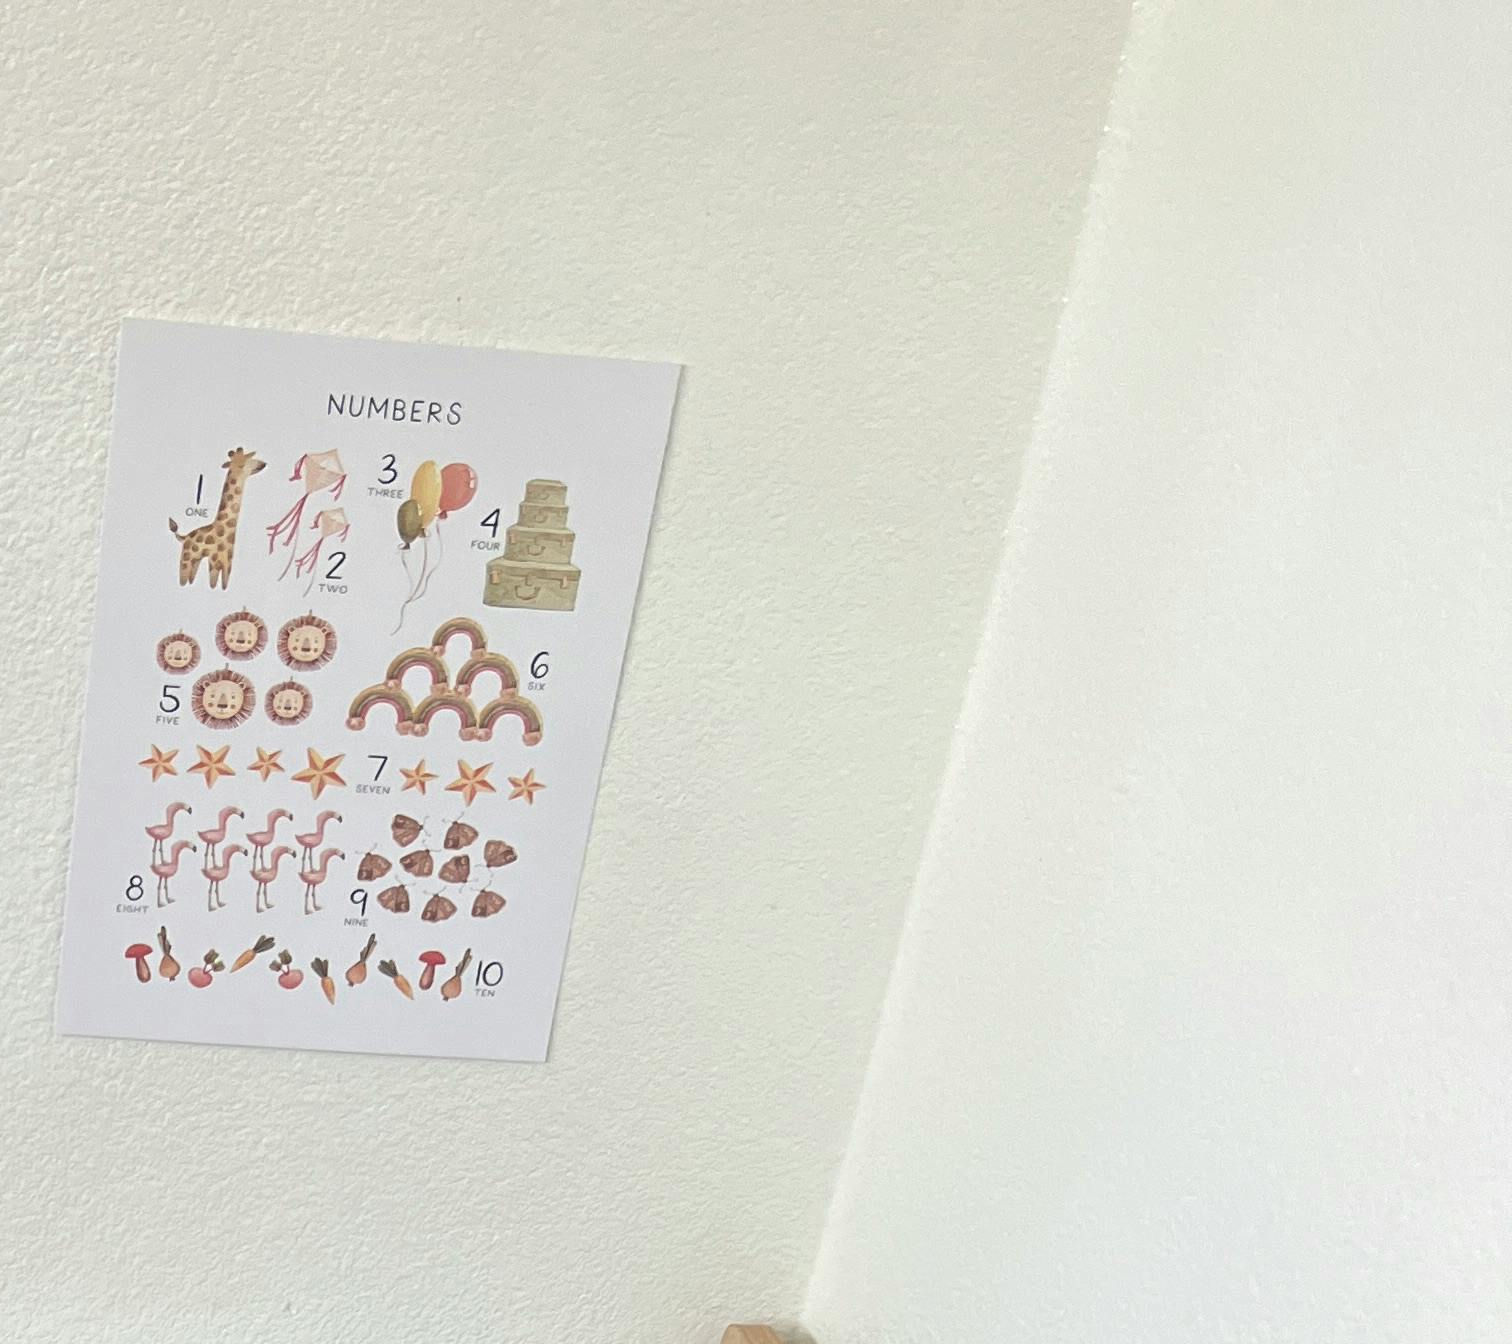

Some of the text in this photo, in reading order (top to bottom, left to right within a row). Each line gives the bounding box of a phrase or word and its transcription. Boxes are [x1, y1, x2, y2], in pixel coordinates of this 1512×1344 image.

[327, 393, 462, 425] NUMBERS
[377, 454, 398, 484] 3
[196, 473, 203, 505] 1
[367, 487, 405, 500] THREE
[185, 507, 209, 518] ONE
[480, 508, 501, 538] 4
[470, 540, 501, 552] FOUR
[325, 551, 347, 580] 2
[318, 583, 348, 595] TWO
[530, 651, 549, 679] 6
[159, 684, 181, 713] 5
[528, 681, 546, 691] SIX
[155, 715, 181, 726] FIVE
[367, 755, 388, 781] 7
[355, 783, 391, 795] SEVEN
[126, 875, 144, 901] 8
[115, 904, 149, 914] EIGHT
[350, 889, 368, 917] 9
[344, 918, 368, 927] NINE
[475, 960, 504, 987] 10
[475, 989, 496, 997] TEN
